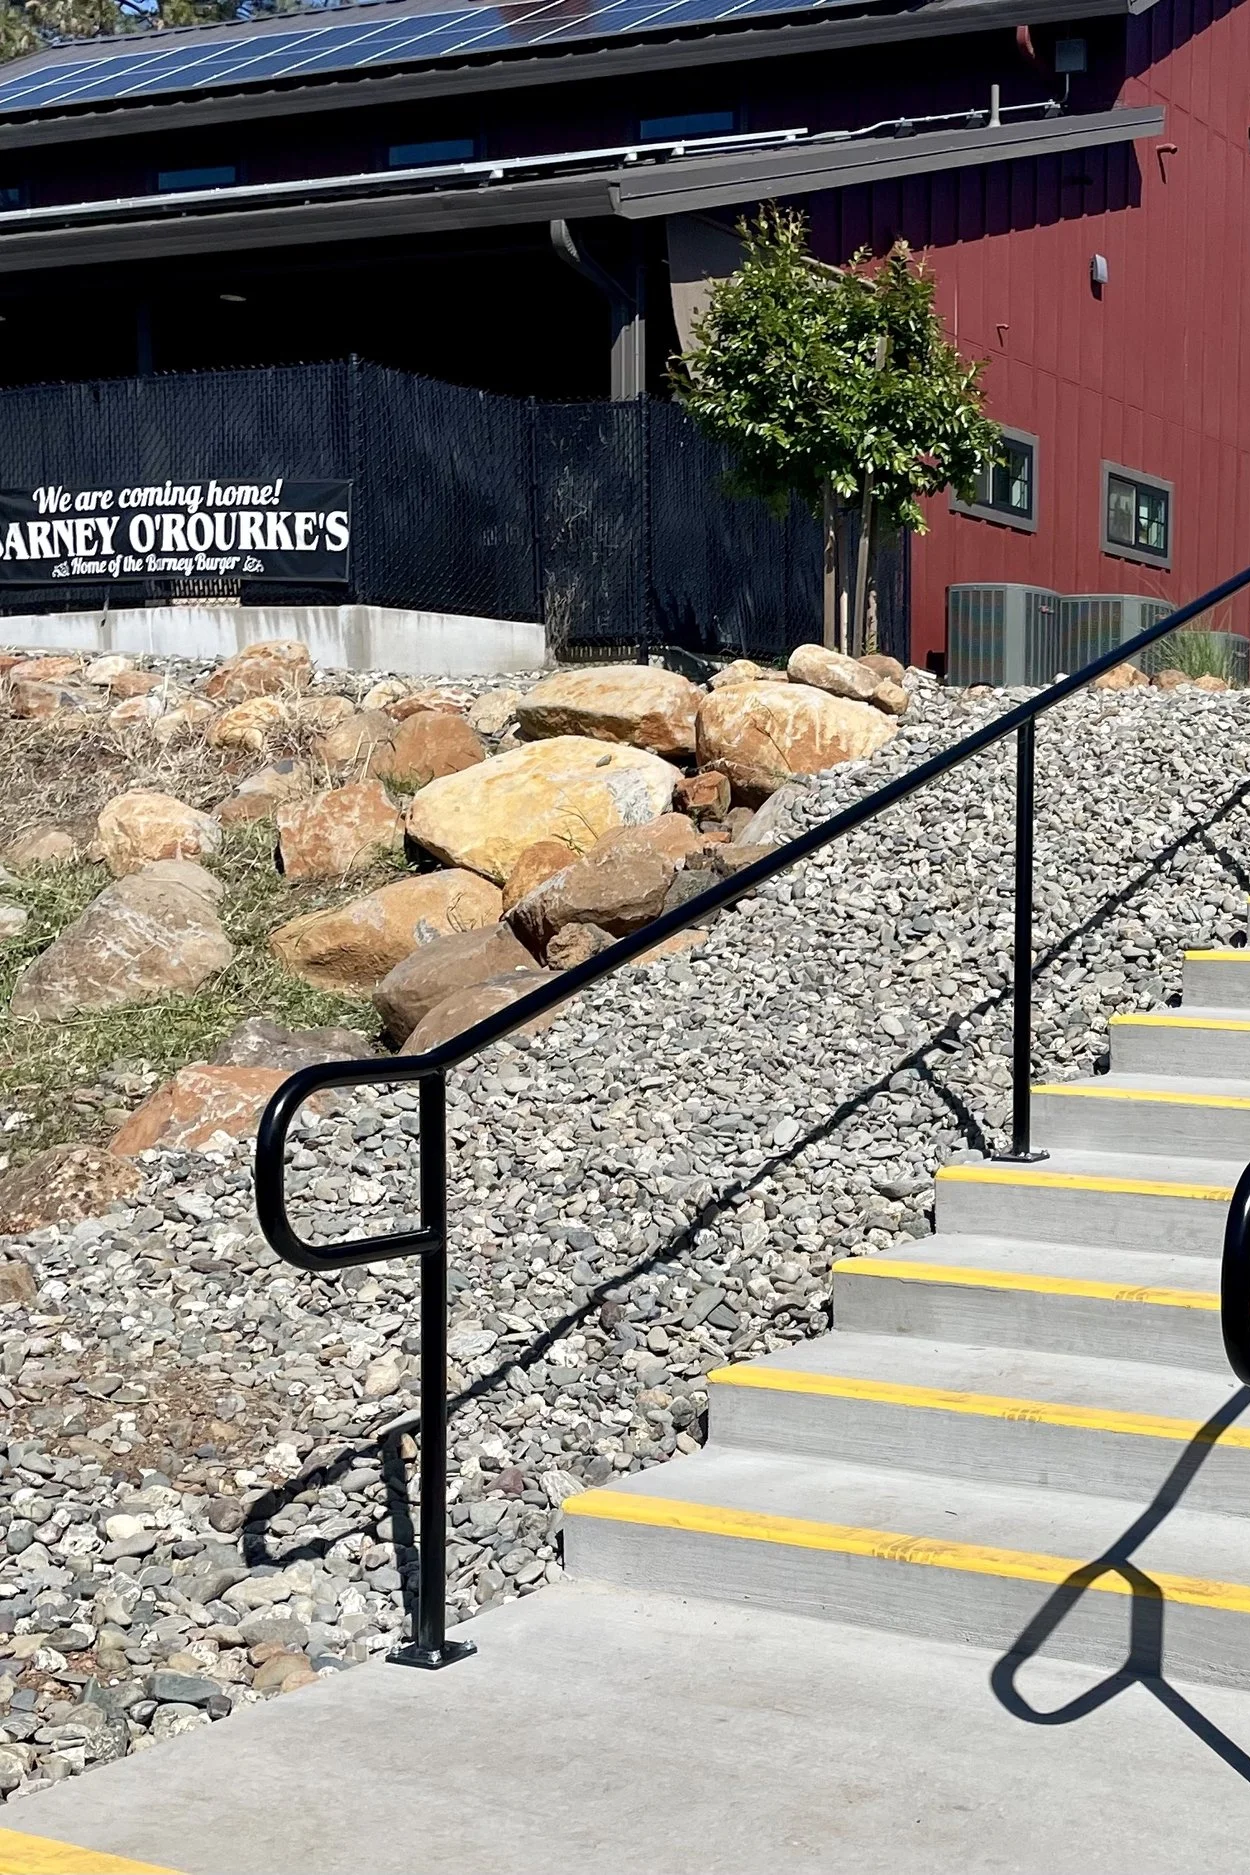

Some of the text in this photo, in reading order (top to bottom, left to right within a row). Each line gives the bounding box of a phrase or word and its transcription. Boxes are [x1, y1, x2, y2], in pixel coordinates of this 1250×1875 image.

[32, 478, 283, 514] We are coming home!
[0, 510, 350, 560] ARNEY O'ROURKE'S
[70, 552, 240, 578] Home of the Barney Burger
